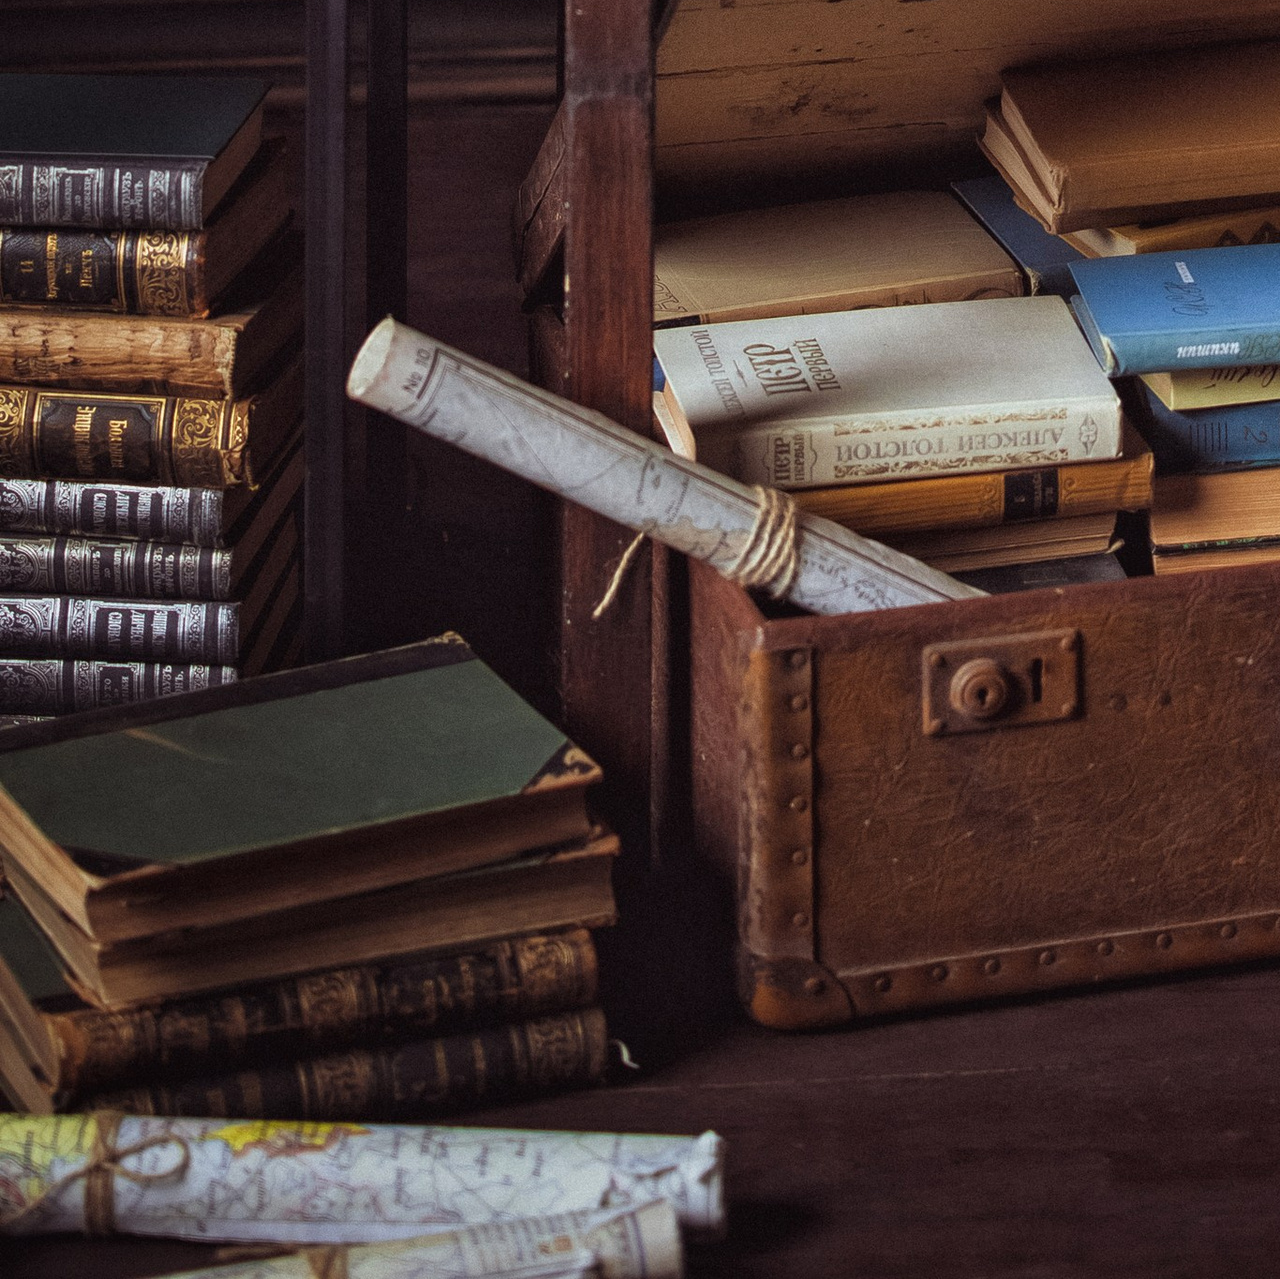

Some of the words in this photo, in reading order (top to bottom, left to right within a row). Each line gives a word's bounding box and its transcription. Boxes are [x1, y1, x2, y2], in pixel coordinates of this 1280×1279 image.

[689, 328, 726, 376] ТОЛСТОЙ
[793, 337, 841, 392] ПЕРВЫЙ
[835, 435, 952, 462] ТОЛСТОЙ
[958, 427, 1065, 452] АЛЕКСЕЙ
